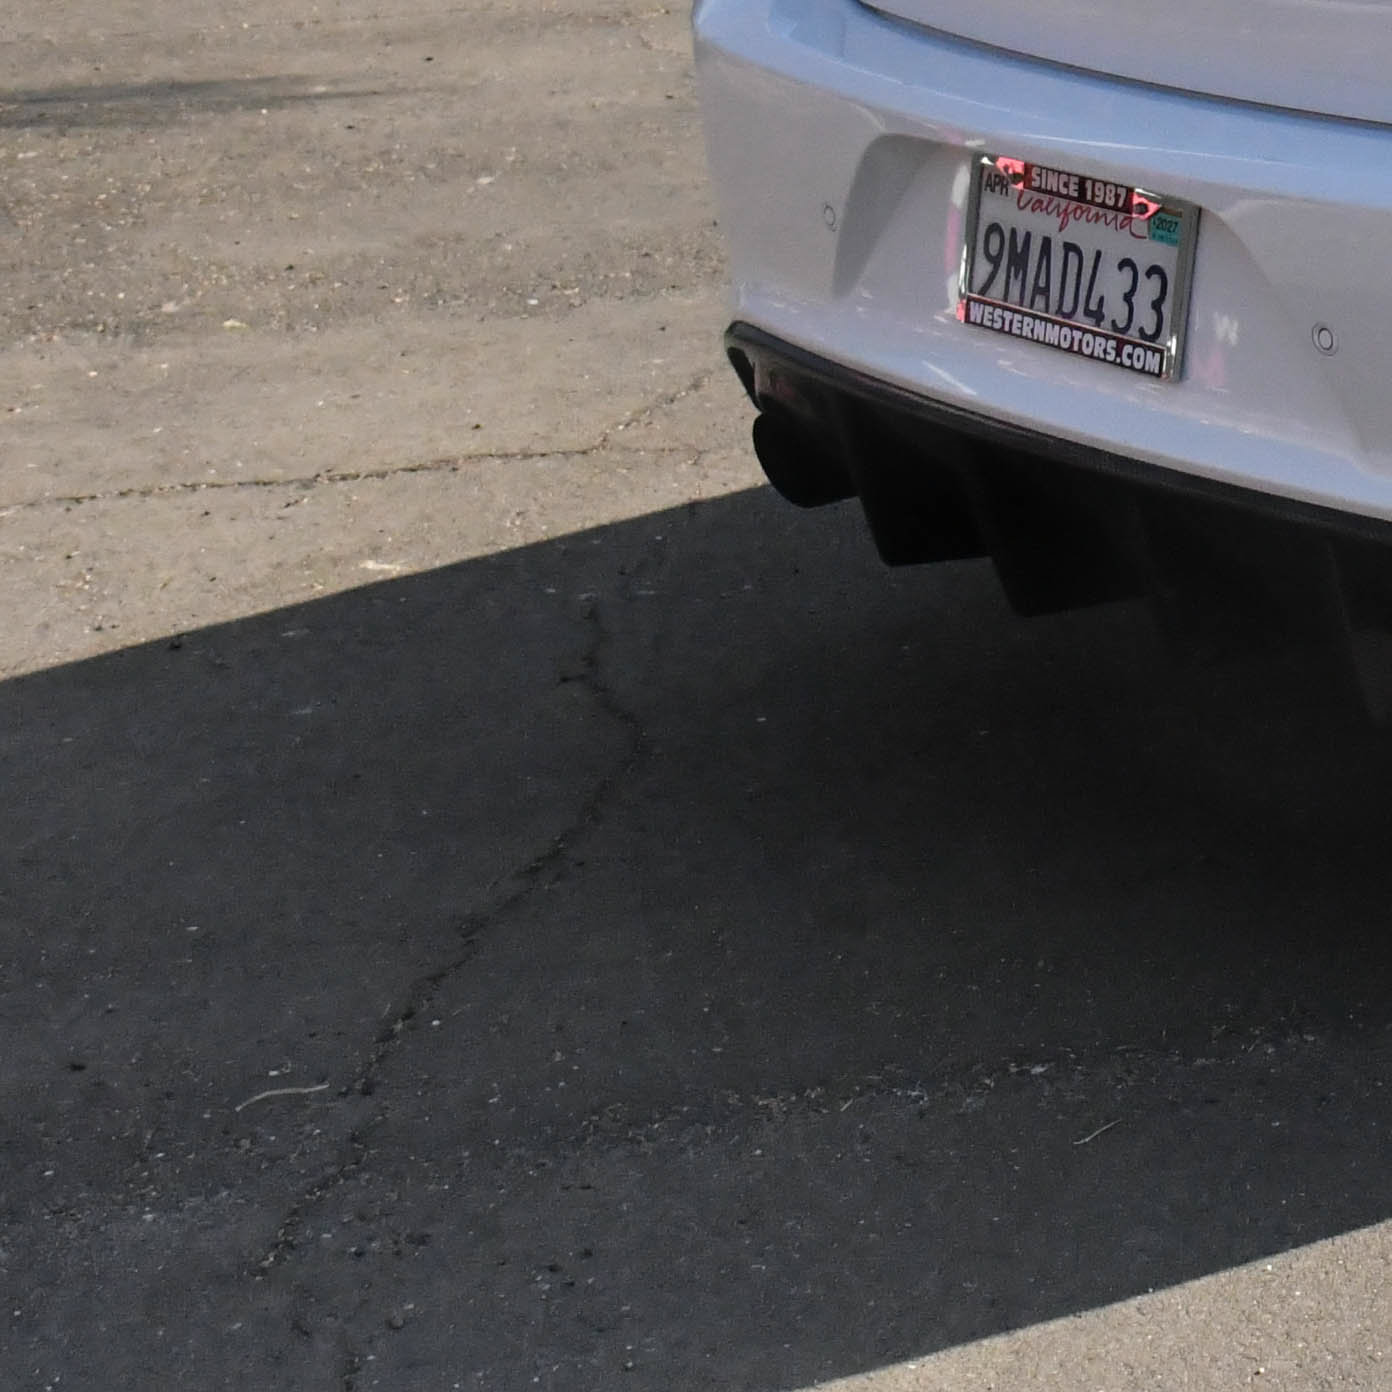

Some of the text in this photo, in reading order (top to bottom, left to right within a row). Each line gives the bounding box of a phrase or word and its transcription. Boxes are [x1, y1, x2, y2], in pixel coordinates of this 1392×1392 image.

[983, 173, 1010, 198] APR
[1030, 166, 1128, 208] SINCE 1987
[1017, 192, 1149, 240] California
[1154, 217, 1179, 234] 2027
[977, 221, 1169, 343] 9MAD433
[968, 301, 1161, 374] WESTERNMOTORS.COM
